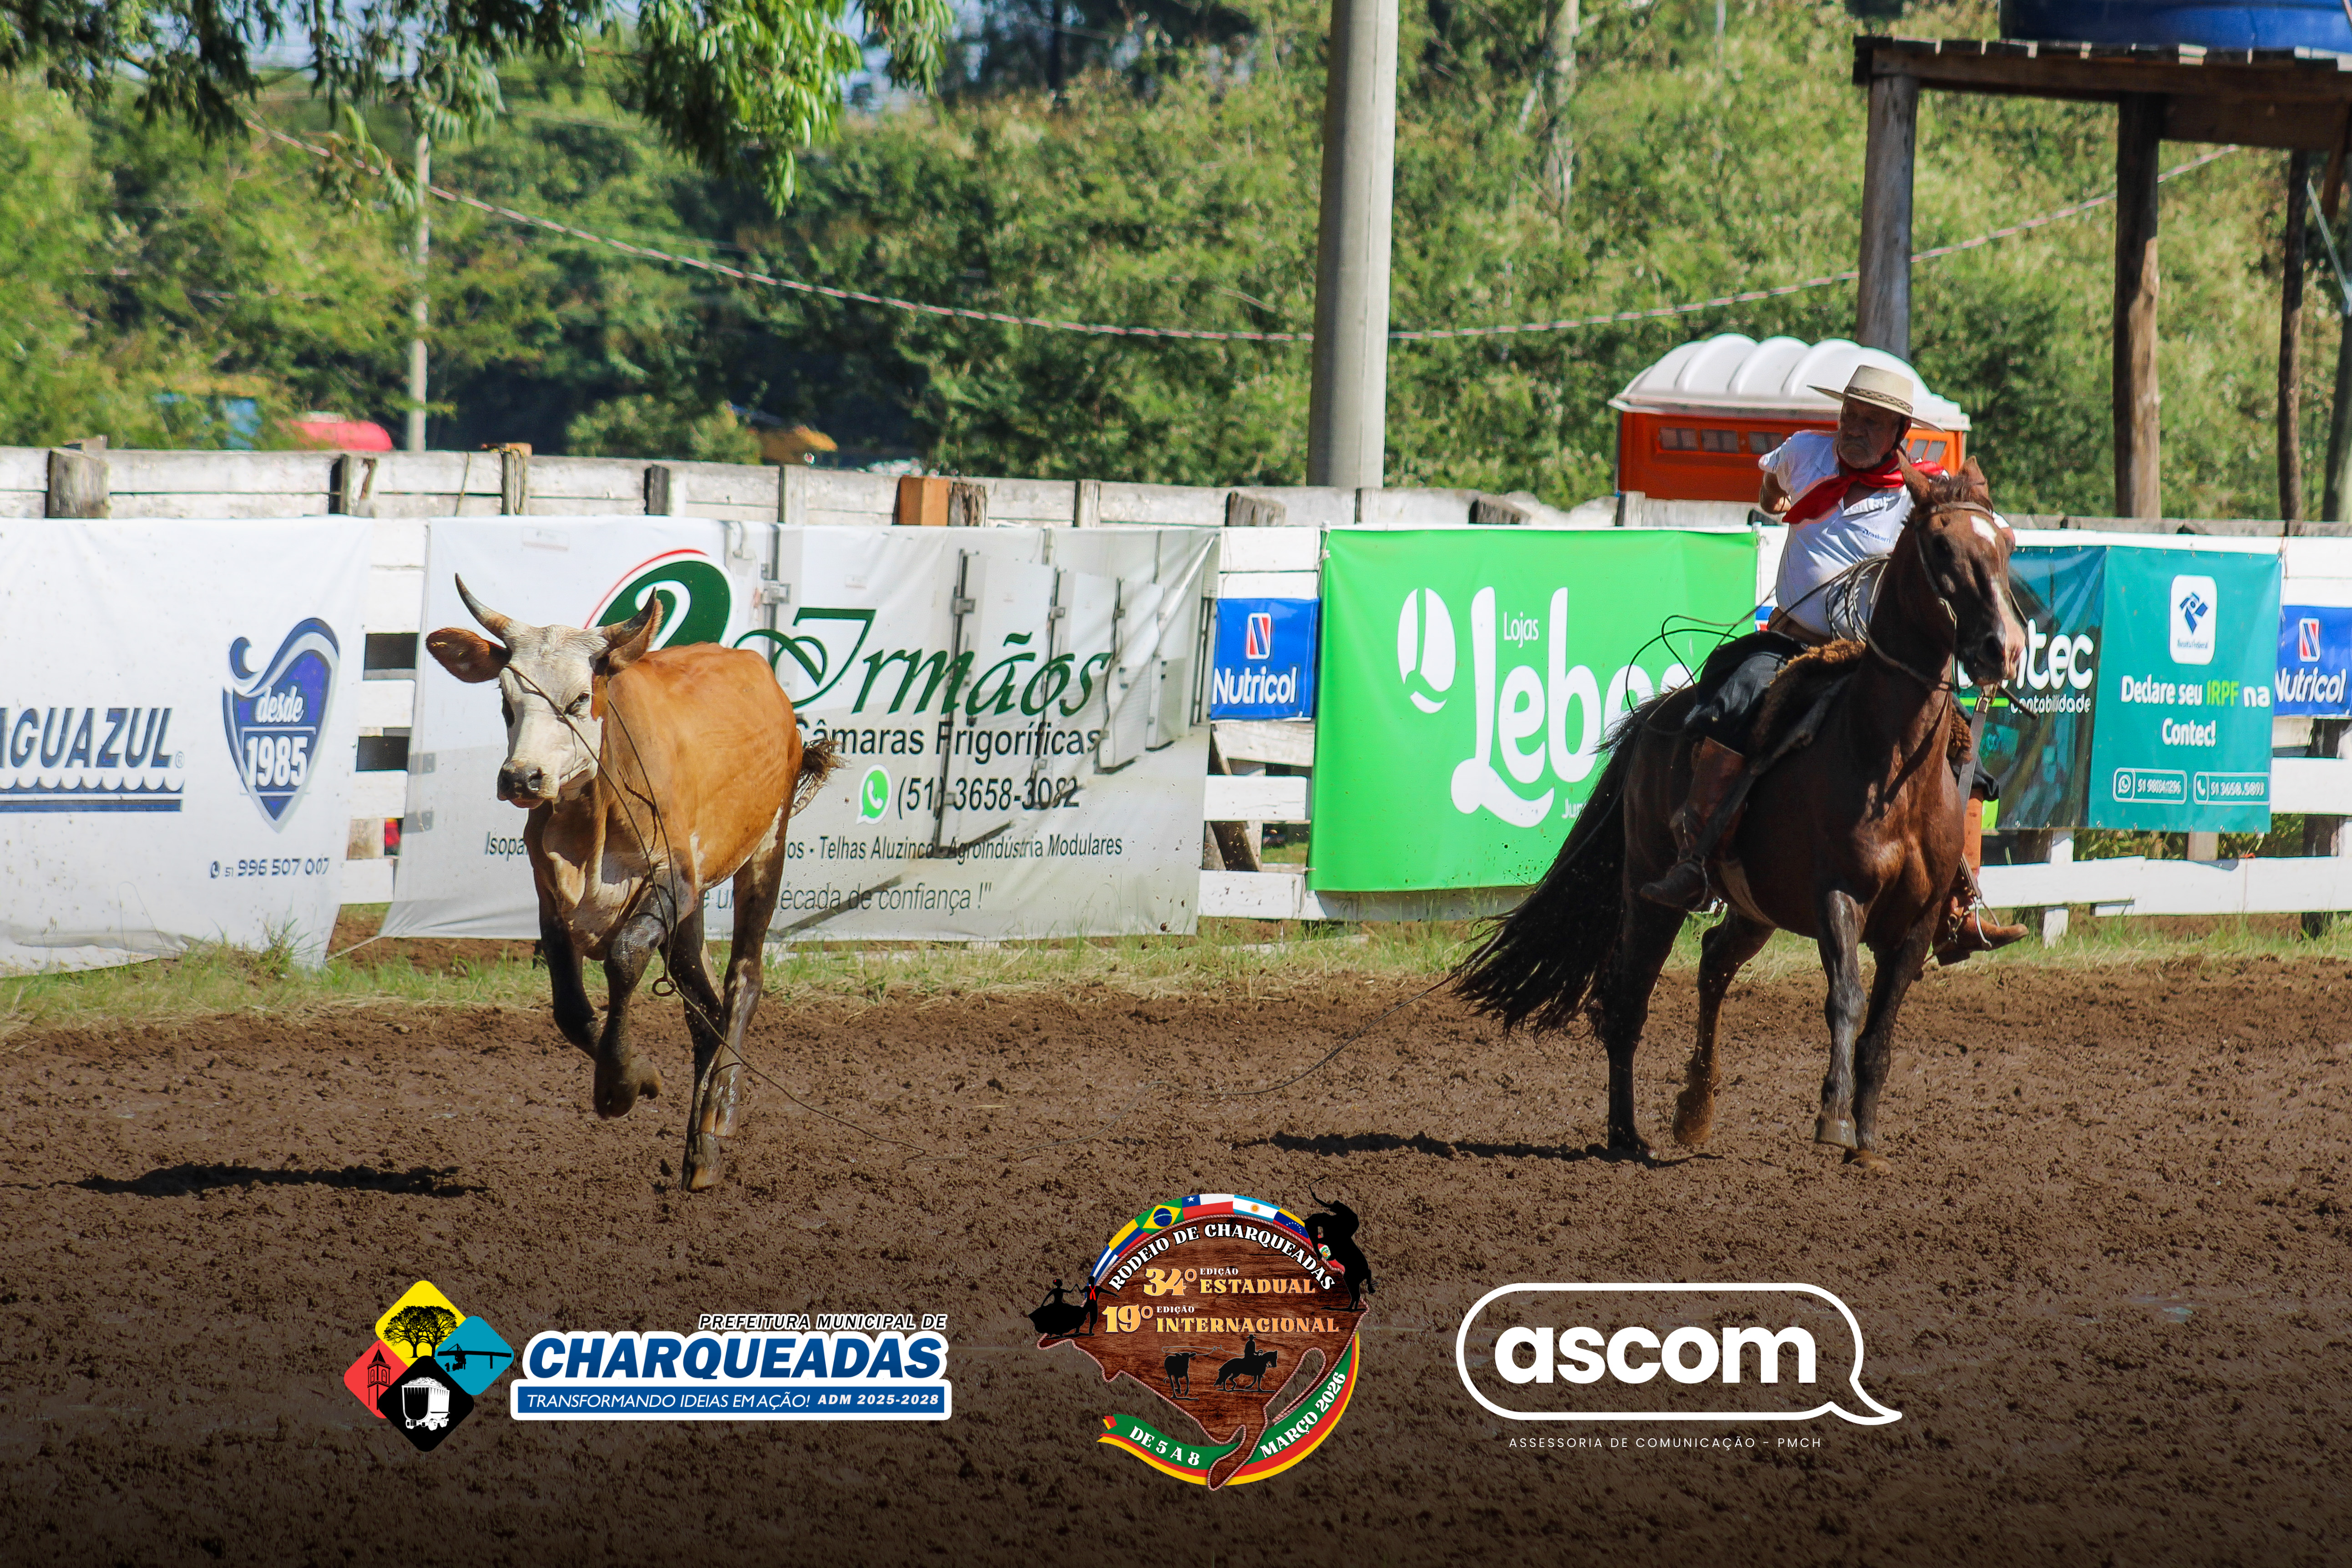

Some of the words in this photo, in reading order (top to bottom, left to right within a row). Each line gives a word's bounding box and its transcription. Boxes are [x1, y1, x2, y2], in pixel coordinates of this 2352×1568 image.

[1503, 611, 1539, 648] Lojas
[734, 607, 1112, 717] Irmãos
[1211, 665, 1297, 705] Nutricol
[2121, 674, 2176, 705] Declare
[2178, 683, 2203, 706] seu
[2206, 680, 2240, 707] IRPF
[2244, 686, 2271, 708] na
[2275, 666, 2347, 703] Nutricol
[256, 685, 304, 723] desde
[1451, 586, 1695, 828] Leb
[796, 718, 925, 754] Câmaras
[936, 721, 1102, 764] Frigoríficas
[2162, 717, 2216, 748] Contec!
[247, 735, 308, 787] 1985
[954, 776, 1080, 811] 3658-3082
[225, 866, 233, 877] 51
[238, 859, 268, 876] 996
[272, 858, 301, 876] 507
[305, 857, 330, 875] 007
[485, 832, 528, 861] Isopa
[820, 836, 866, 859] Telhas
[871, 836, 934, 859] Aluzinco
[946, 835, 1043, 865] Agroindústria
[1047, 833, 1123, 857] Modulares
[778, 881, 840, 909] écada
[849, 883, 872, 910] de
[879, 882, 971, 916] confiança
